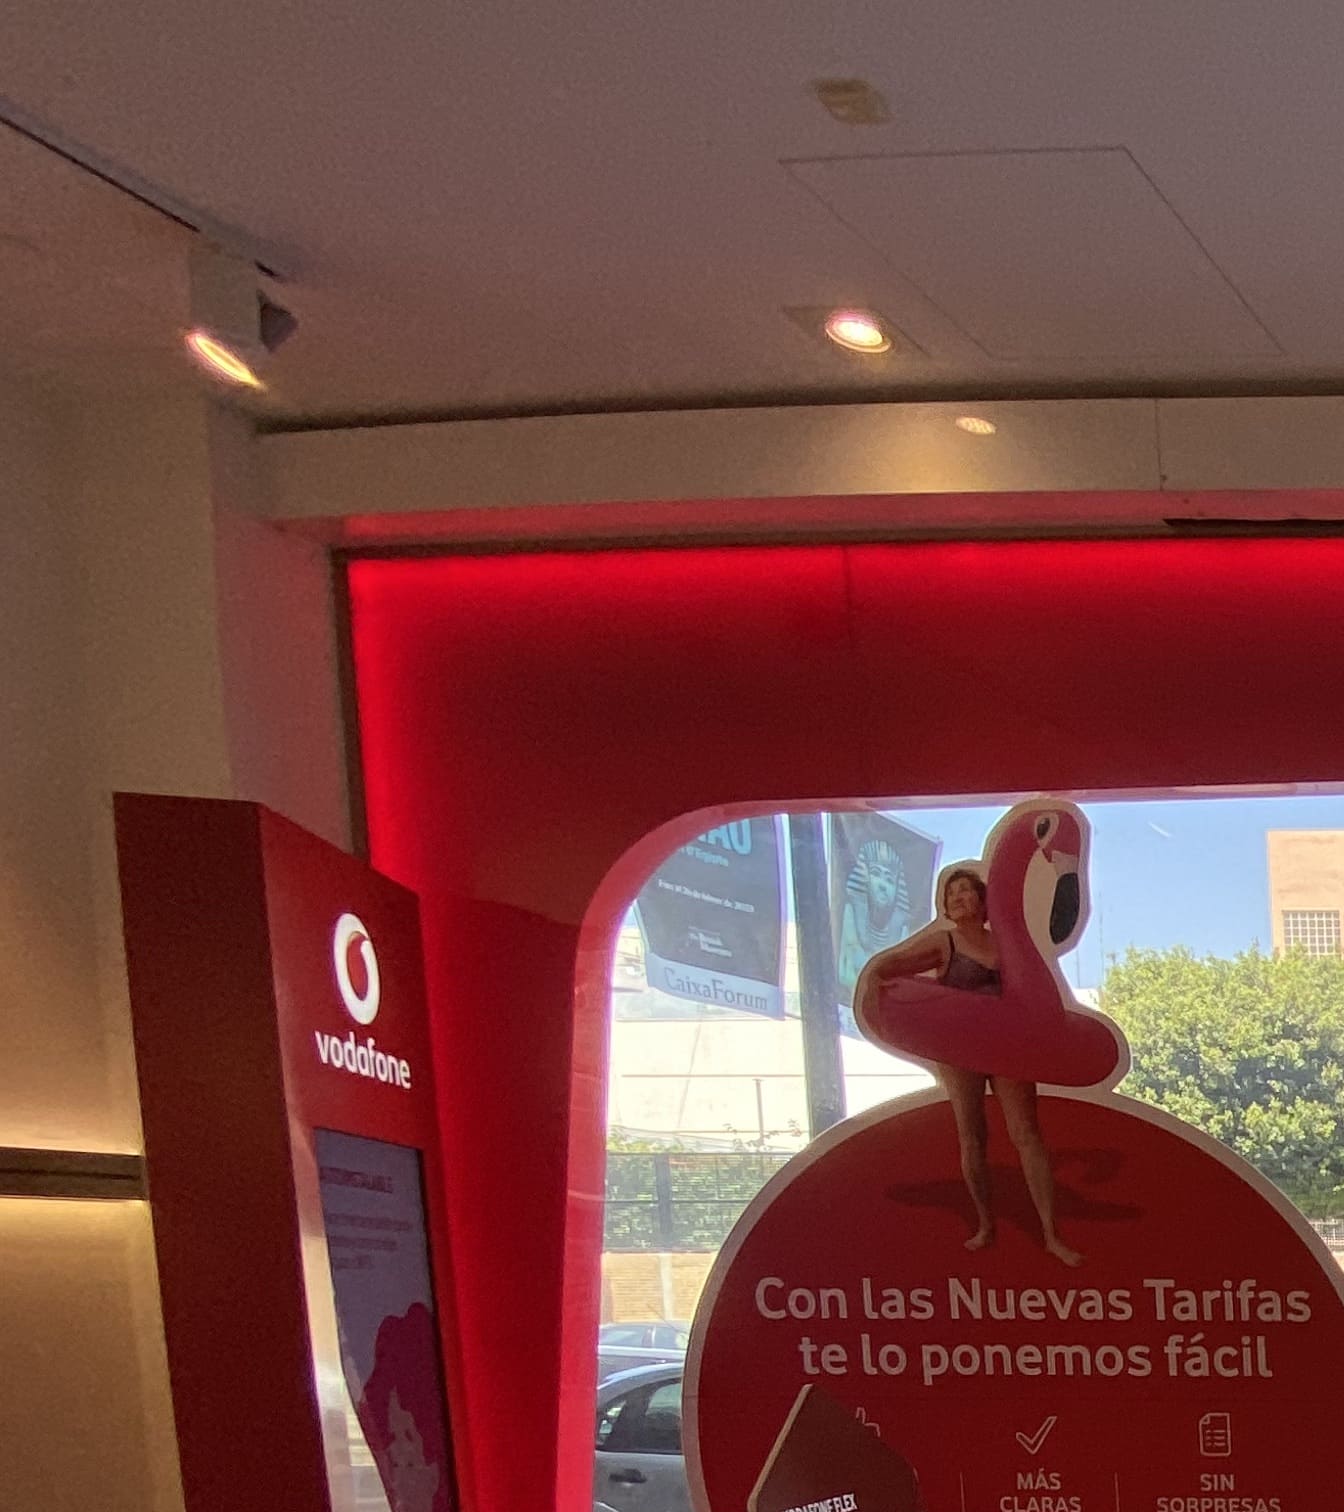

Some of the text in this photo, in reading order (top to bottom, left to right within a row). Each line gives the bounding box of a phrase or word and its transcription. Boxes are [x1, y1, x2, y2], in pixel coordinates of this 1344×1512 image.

[664, 967, 768, 1011] CaixaForum
[315, 1031, 411, 1089] vodafone
[755, 1278, 1312, 1322] Con las Nuevas Tarifas
[800, 1335, 1273, 1386] te lo ponemos fácil
[1017, 1468, 1062, 1491] MÁS
[1200, 1473, 1236, 1492] SIN
